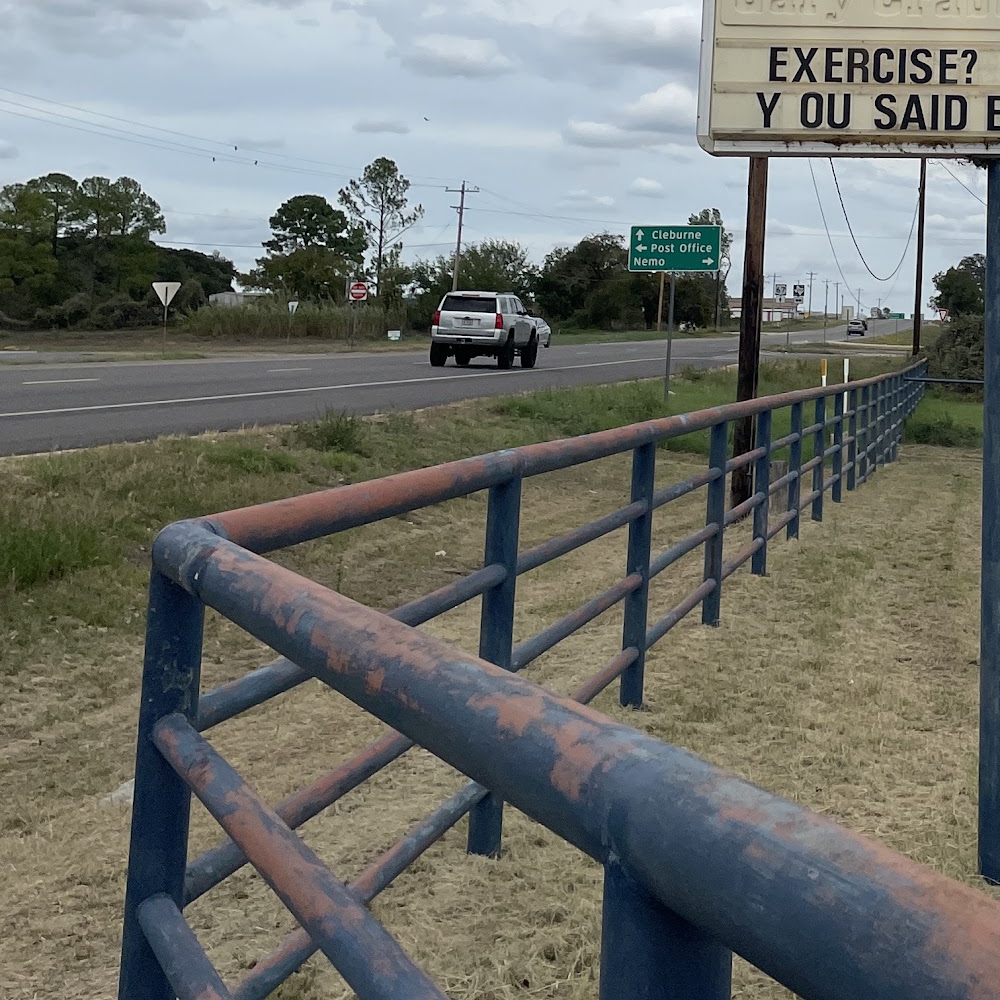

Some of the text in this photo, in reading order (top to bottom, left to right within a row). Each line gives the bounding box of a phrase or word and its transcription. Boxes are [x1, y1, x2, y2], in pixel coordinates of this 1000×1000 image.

[768, 46, 978, 85] EXERCISE?
[873, 93, 968, 131] SAID
[651, 230, 702, 240] Cleburne
[650, 243, 713, 253] Post Office
[633, 257, 666, 267] Nemo
